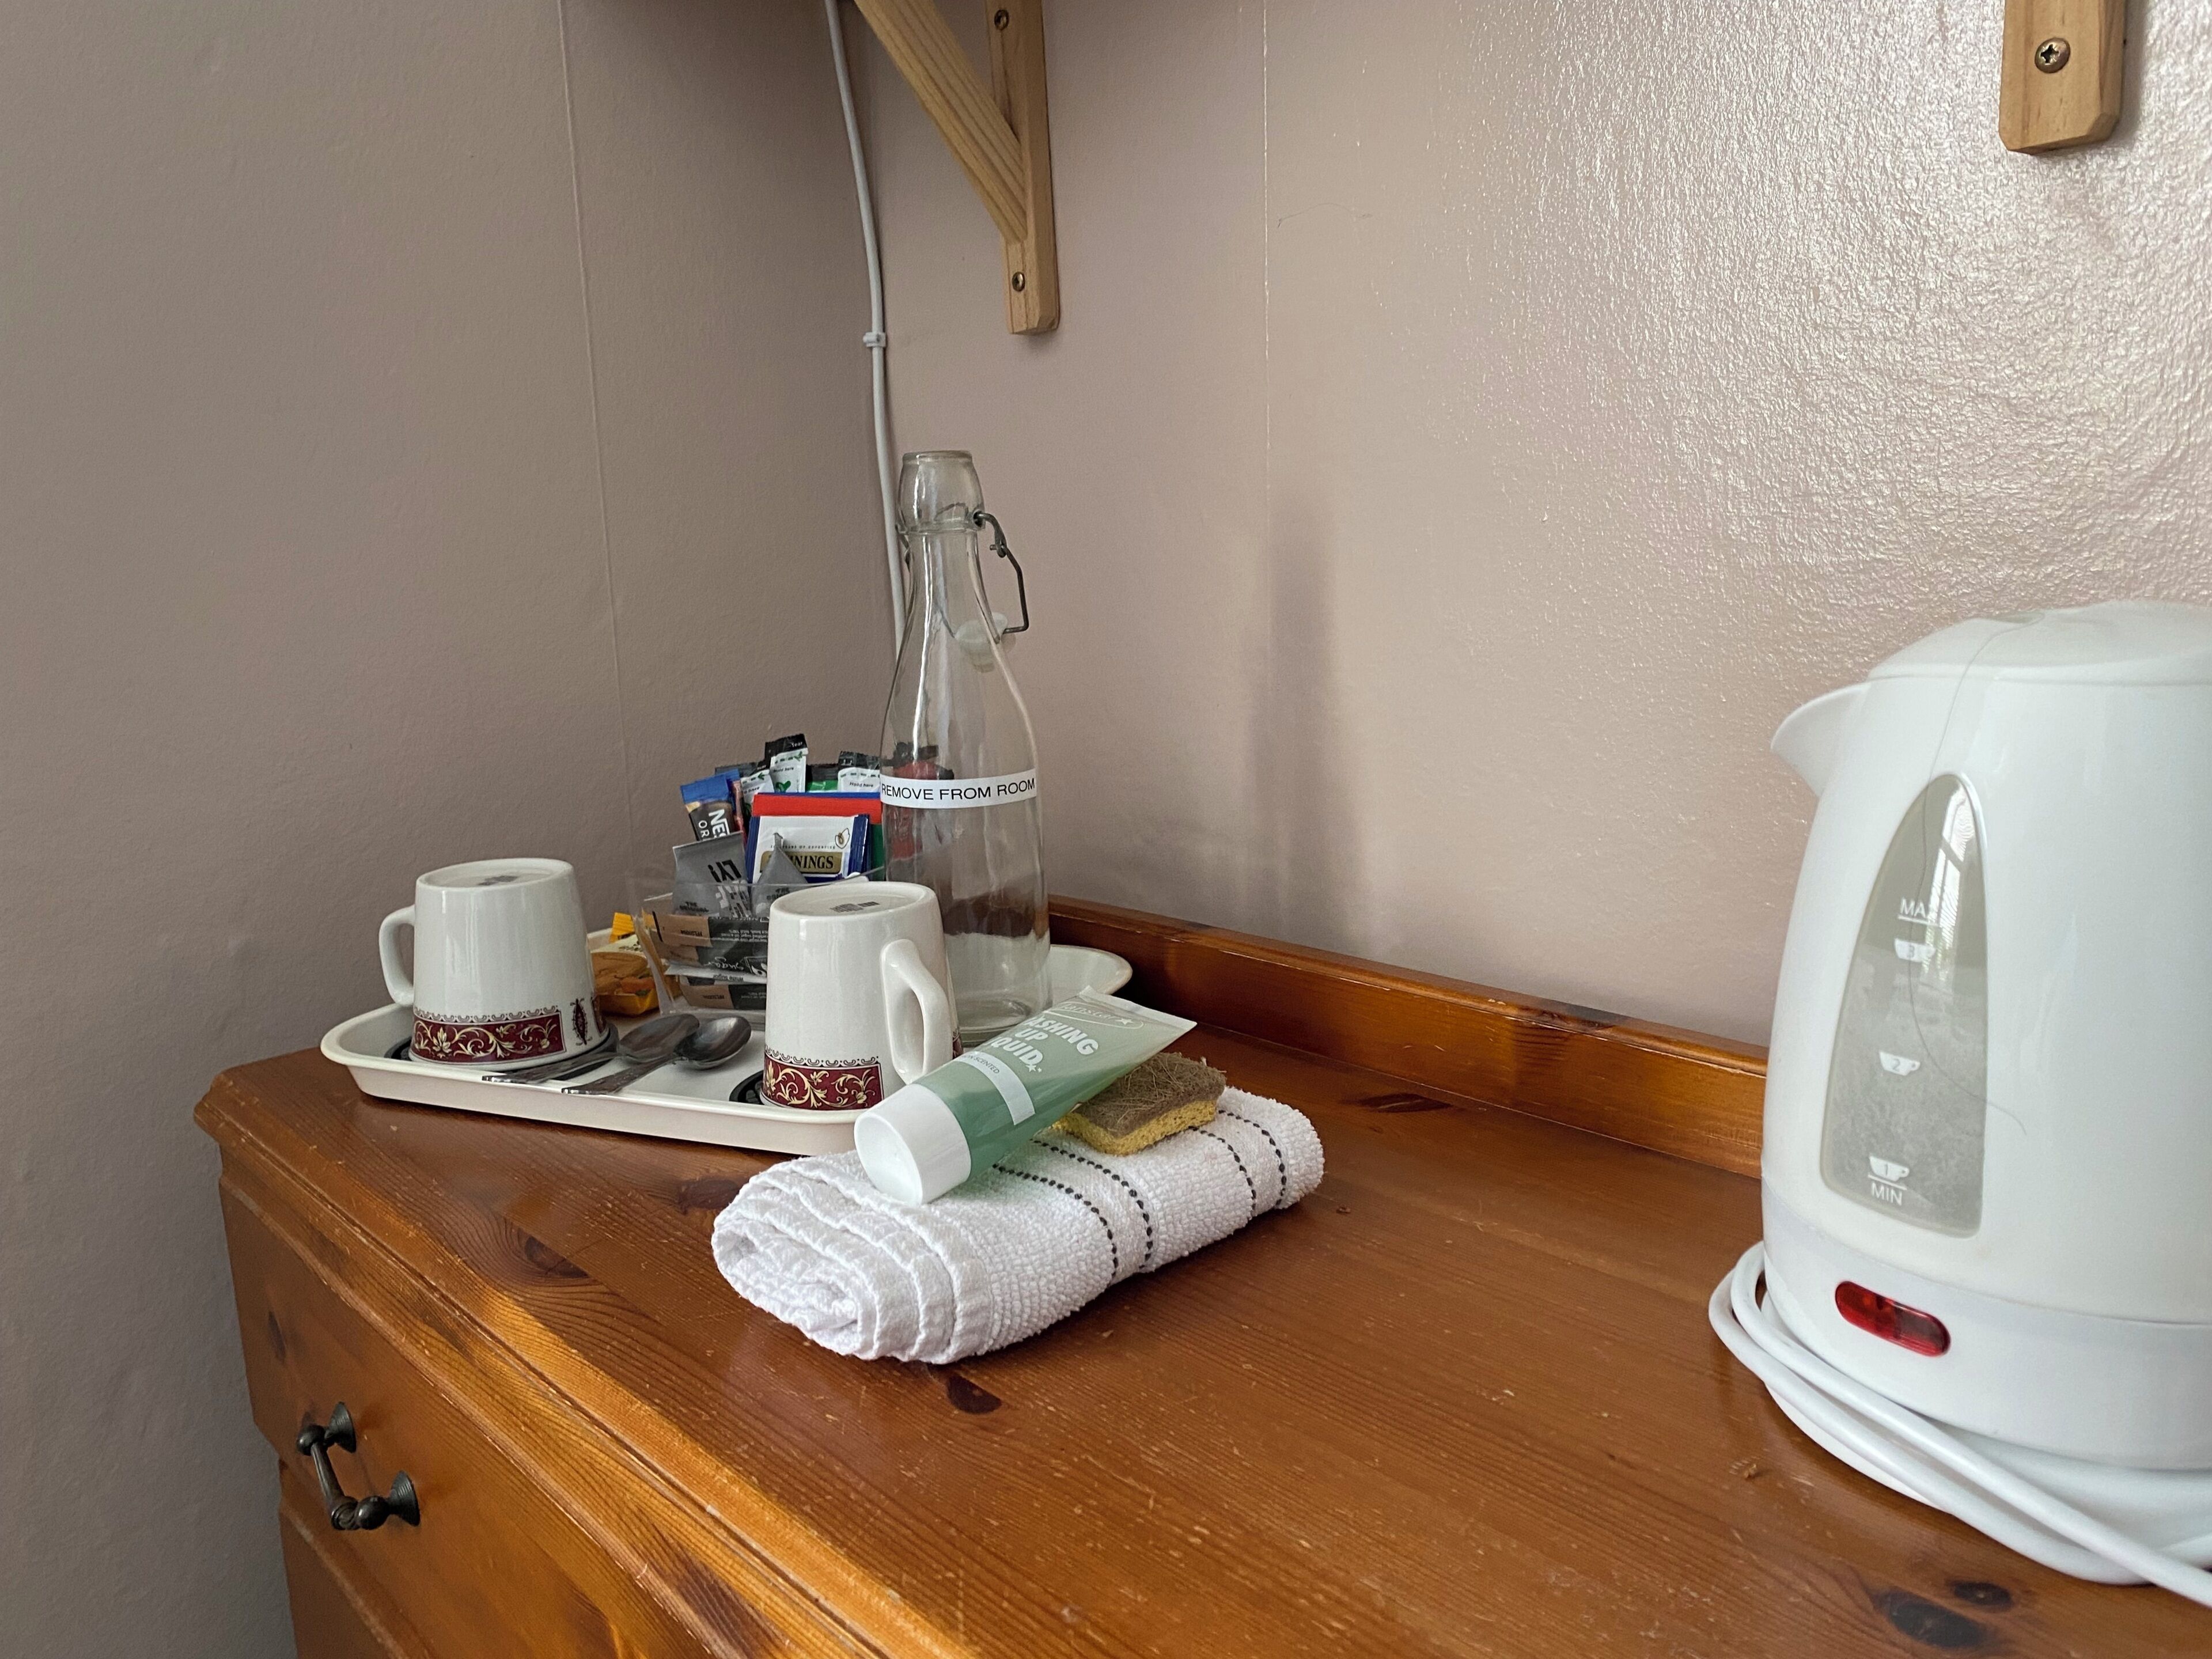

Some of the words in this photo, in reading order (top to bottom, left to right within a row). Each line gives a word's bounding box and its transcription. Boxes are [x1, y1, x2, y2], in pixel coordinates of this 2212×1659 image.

[882, 783, 934, 800] REMOVE
[940, 786, 991, 800] FROM
[997, 778, 1035, 797] ROOM
[707, 859, 741, 883] LY!
[790, 855, 834, 869] NINGS
[1014, 1028, 1048, 1041] UP
[1024, 1016, 1099, 1055] ASHING
[984, 1037, 1044, 1065] IQUID
[974, 1055, 1000, 1074] SCENTED
[1892, 1058, 1901, 1072] 2
[1871, 1182, 1903, 1206] MIN
